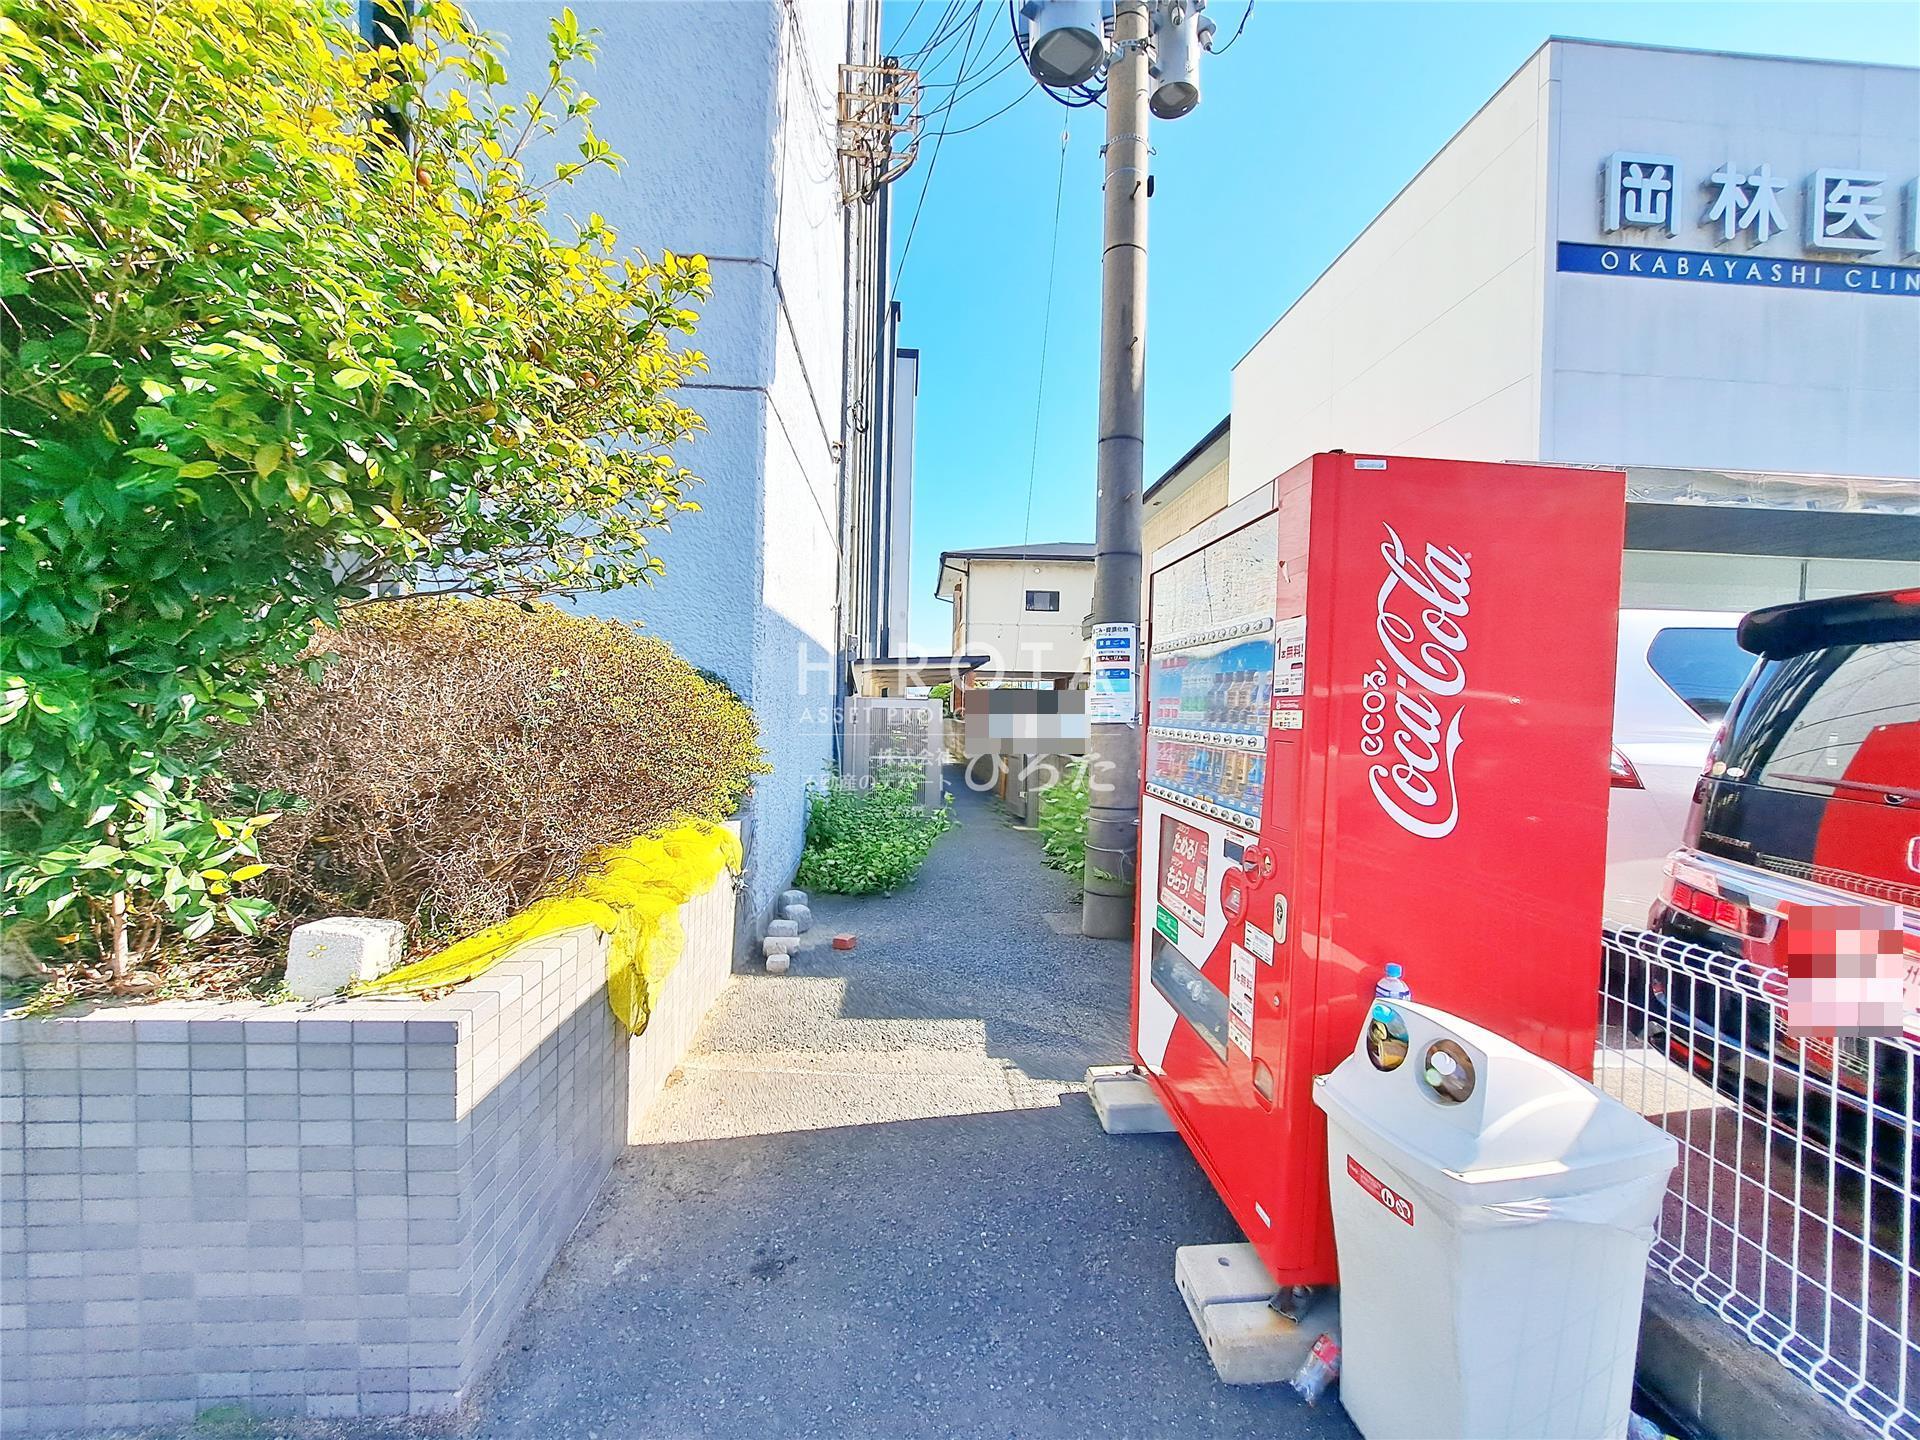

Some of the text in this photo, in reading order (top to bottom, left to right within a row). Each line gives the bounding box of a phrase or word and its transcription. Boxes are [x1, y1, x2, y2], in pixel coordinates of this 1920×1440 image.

[1604, 152, 1920, 254] 岡林医
[1600, 250, 1821, 286] OKABAYASHI
[1368, 521, 1472, 839] Coca-Cola
